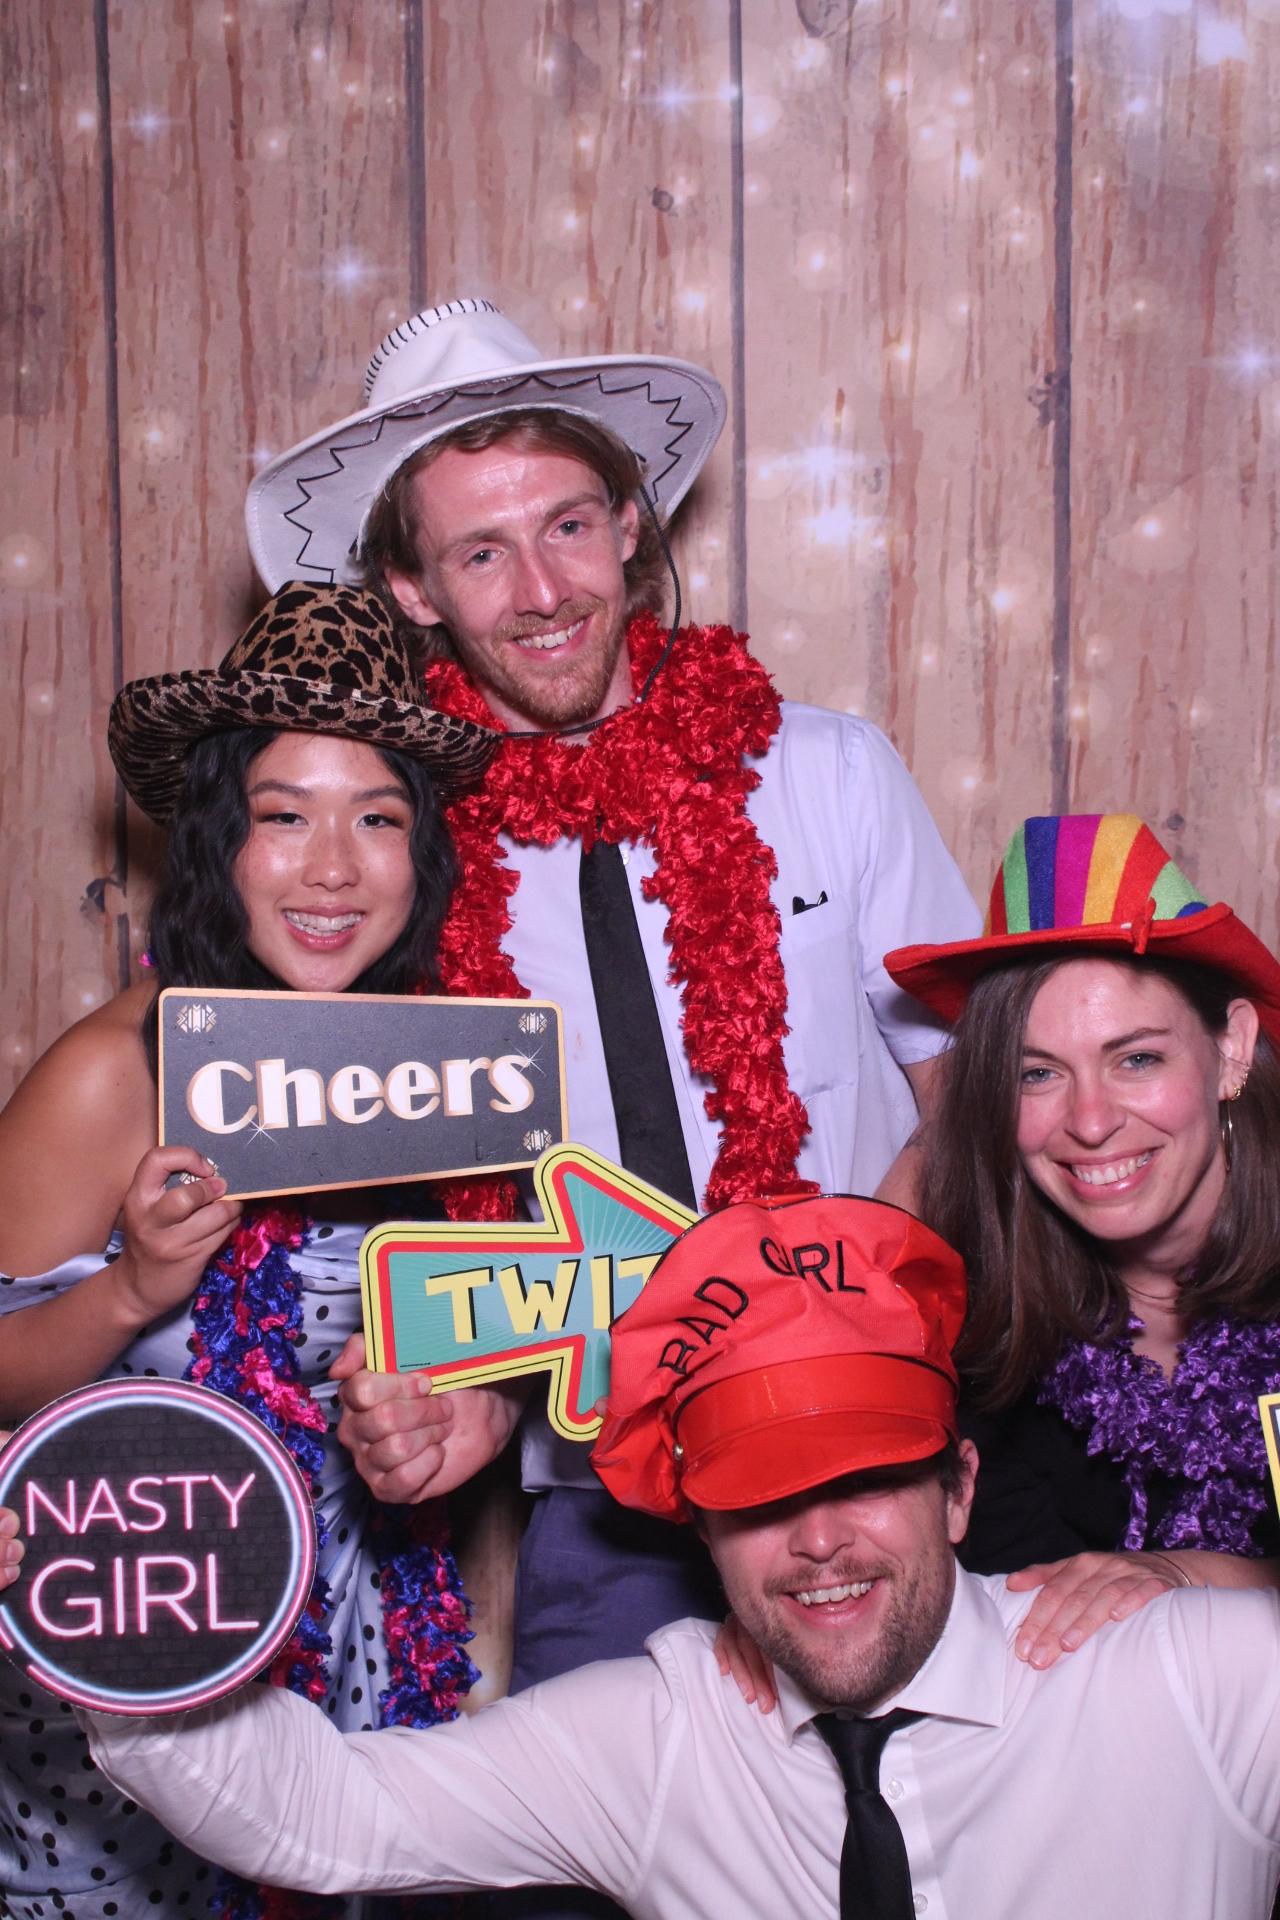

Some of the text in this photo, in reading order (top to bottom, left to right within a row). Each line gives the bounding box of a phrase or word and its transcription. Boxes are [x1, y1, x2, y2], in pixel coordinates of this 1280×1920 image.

[187, 1054, 535, 1134] Cheers
[657, 1276, 749, 1376] BAD
[26, 1473, 256, 1535] NASTY
[30, 1553, 259, 1637] GIRL
